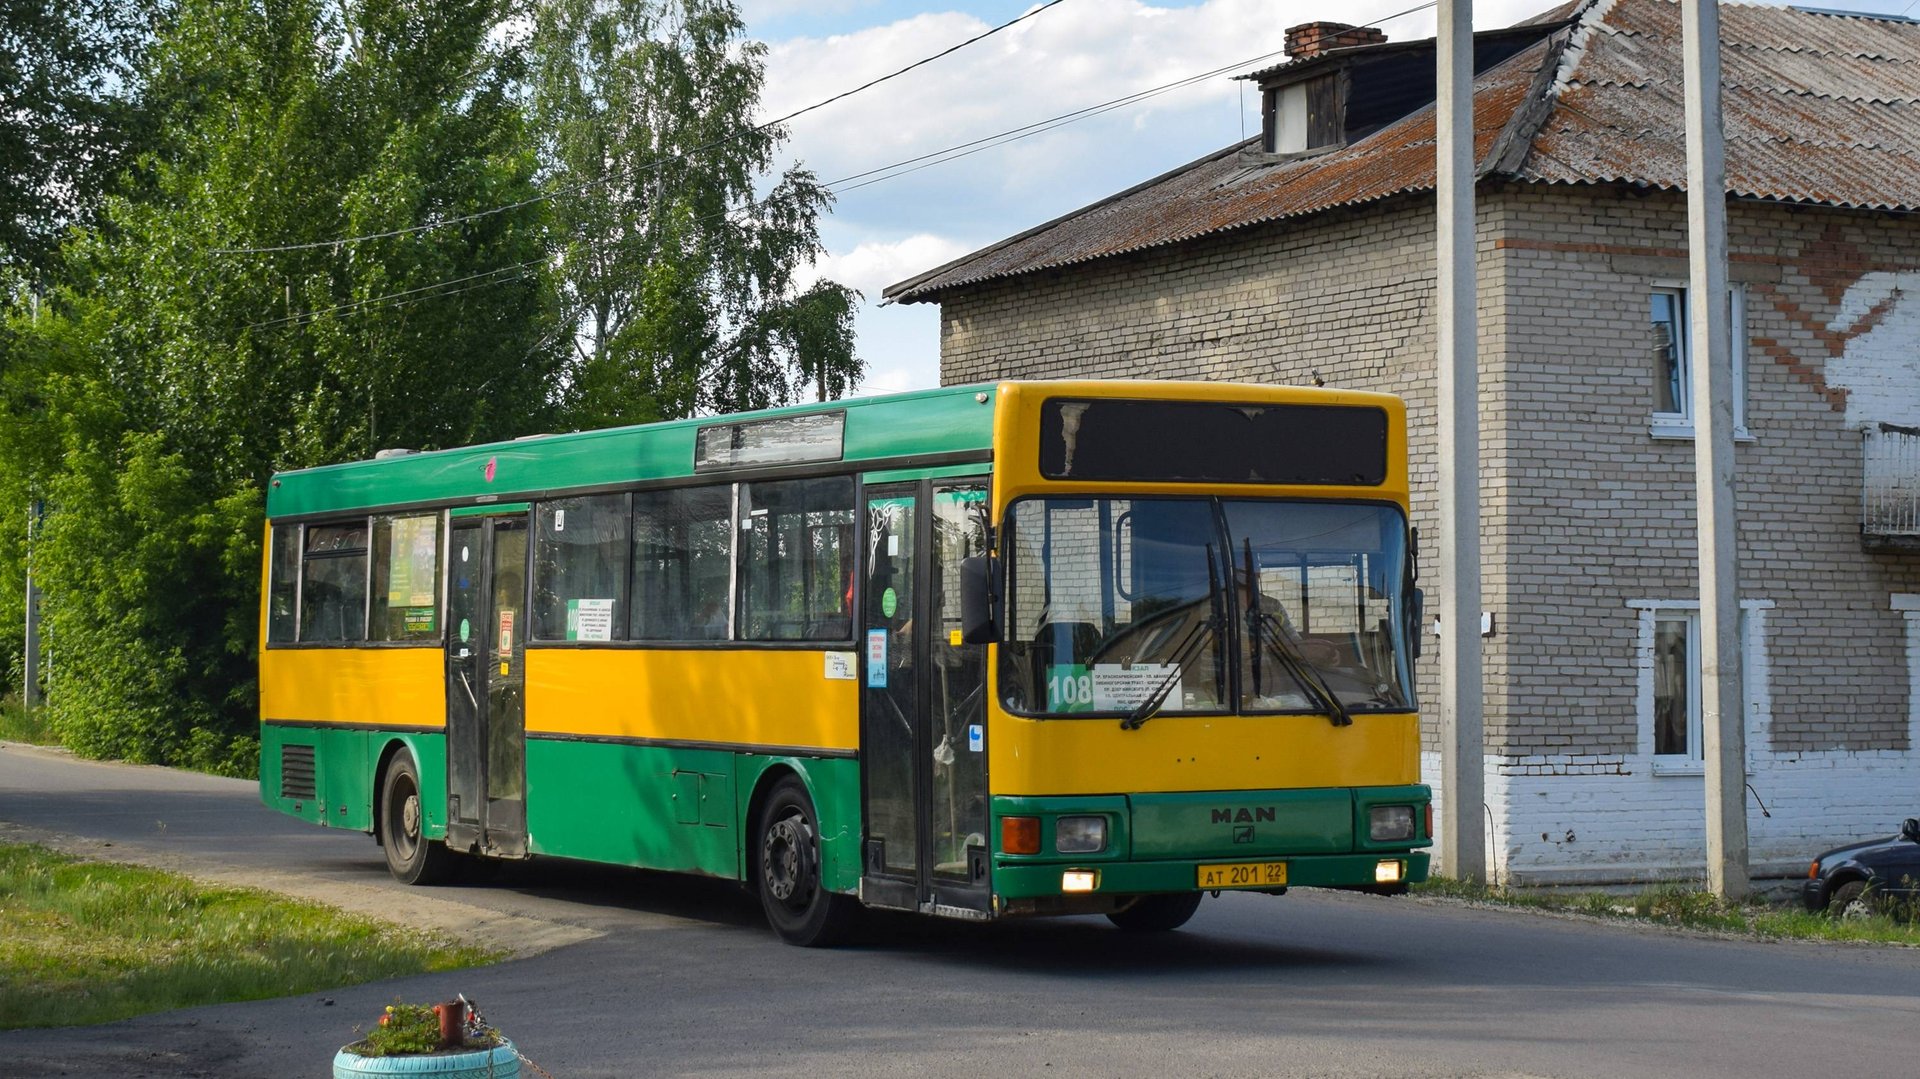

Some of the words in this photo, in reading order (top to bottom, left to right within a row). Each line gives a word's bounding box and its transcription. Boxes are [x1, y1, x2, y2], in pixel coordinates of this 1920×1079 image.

[1048, 675, 1092, 704] 108
[1211, 807, 1276, 824] MAN
[1231, 866, 1258, 884] 201
[1267, 864, 1281, 877] 22
